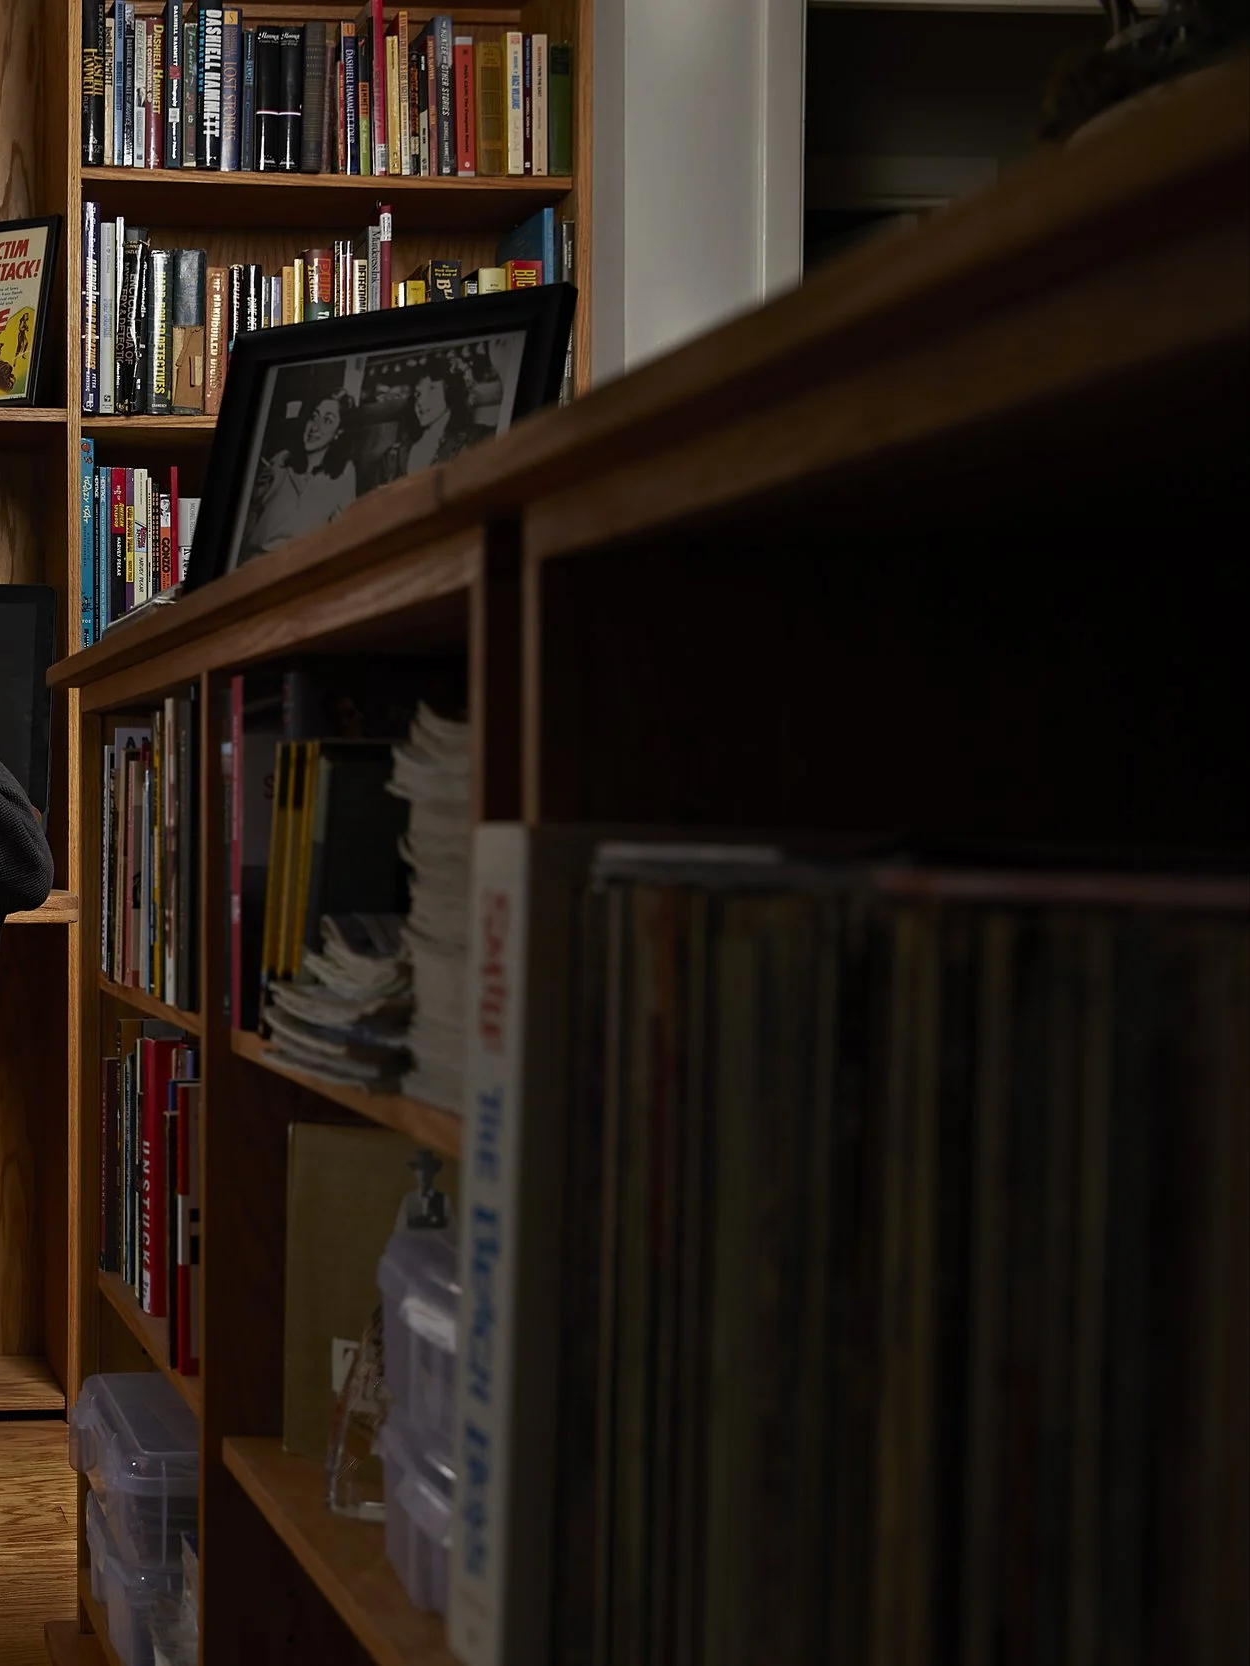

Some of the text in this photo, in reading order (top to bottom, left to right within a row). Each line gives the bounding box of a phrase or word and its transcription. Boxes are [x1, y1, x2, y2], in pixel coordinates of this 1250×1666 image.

[83, 48, 98, 96] HAMMETT
[152, 24, 164, 115] DASHIELL HAMMETT
[203, 9, 222, 138] DASHIELL HAMMETT
[223, 61, 237, 140] LOST STORIES
[345, 49, 355, 117] DASHIELL HAMMETT
[359, 84, 368, 116] HAMMETT
[440, 29, 449, 116] HUNTER OTHER STORIES
[318, 258, 332, 304] PULP
[369, 229, 380, 284] Murderess Ink
[155, 336, 167, 395] DETECTIVES
[162, 537, 170, 573] GONZO
[142, 1140, 151, 1268] UNSTUCK
